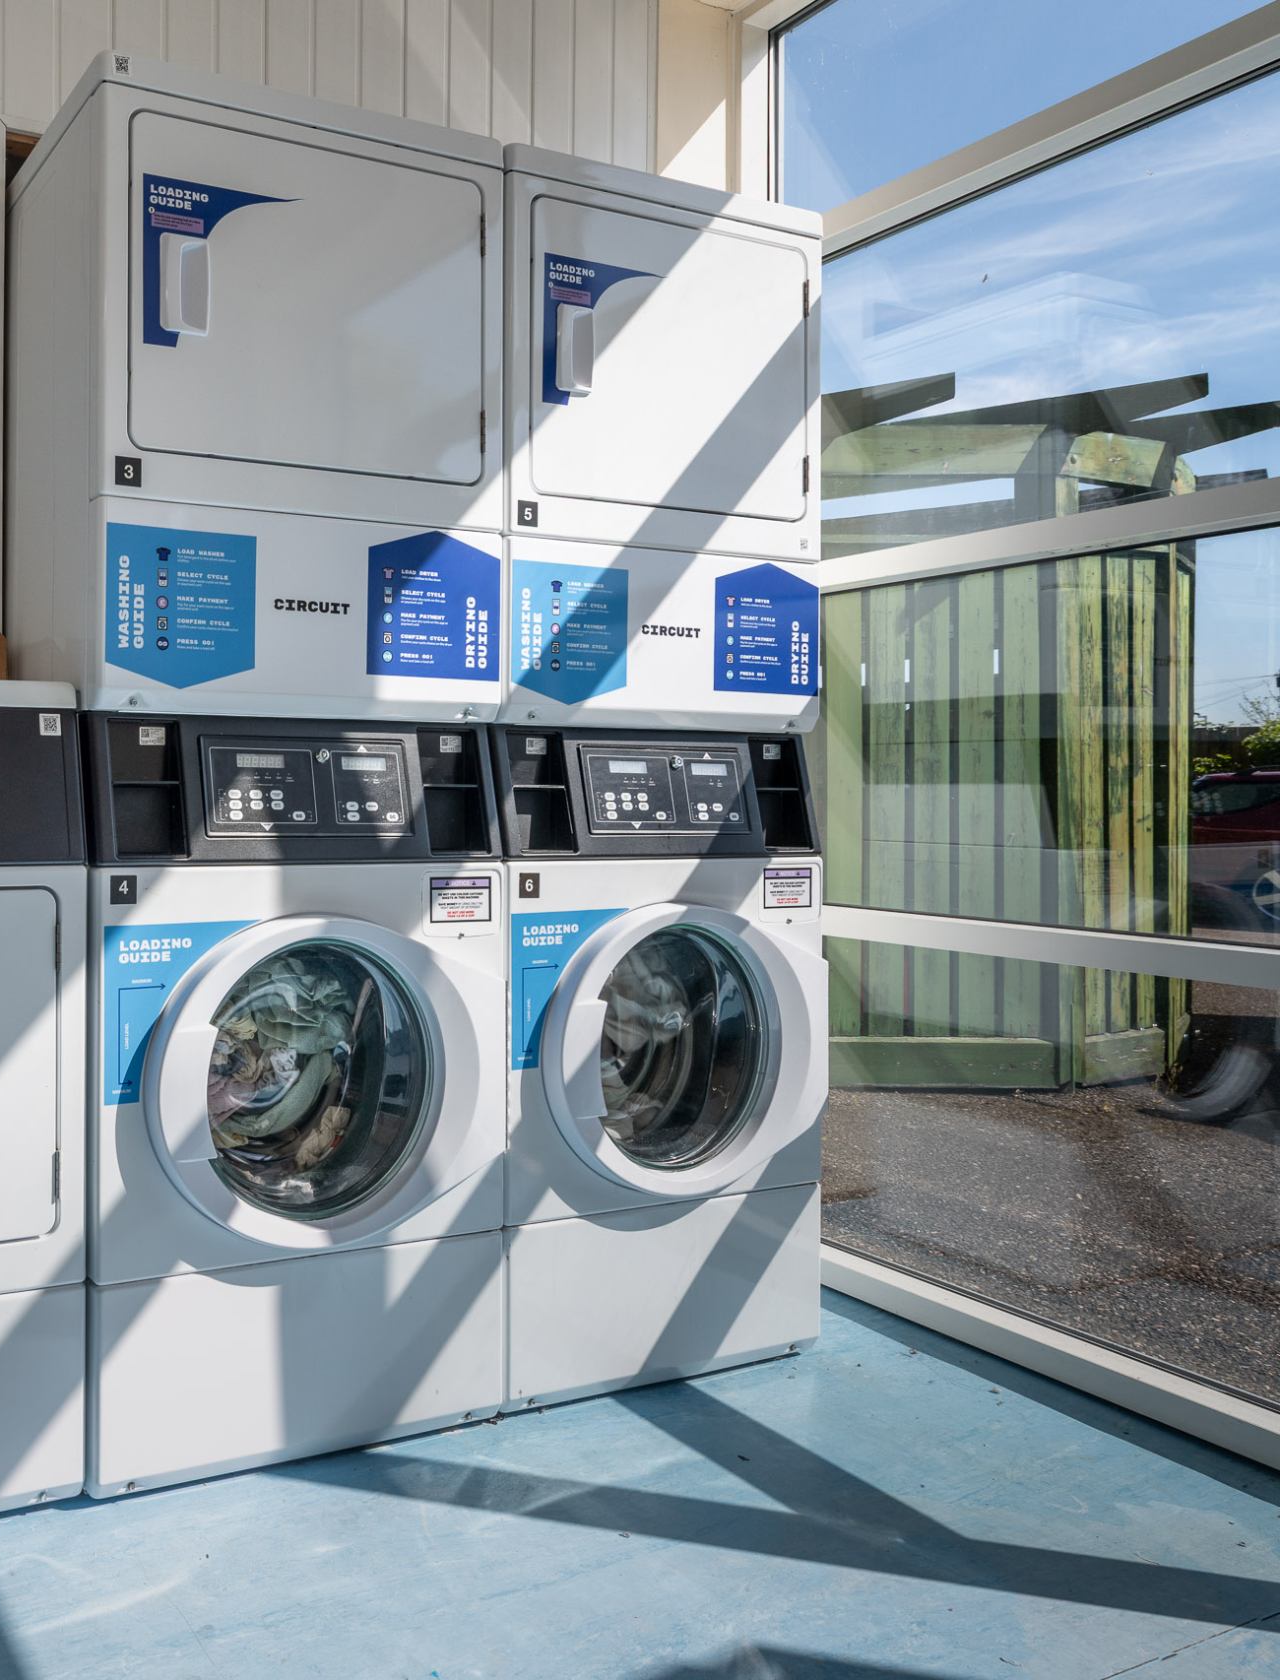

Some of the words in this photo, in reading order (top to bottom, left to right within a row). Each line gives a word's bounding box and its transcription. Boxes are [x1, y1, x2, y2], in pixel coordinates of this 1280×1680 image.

[150, 183, 209, 203] LOADING
[149, 195, 192, 211] GUIDE
[549, 261, 596, 278] LOADING
[549, 271, 582, 285] GUIDE
[124, 465, 133, 479] 3
[524, 508, 532, 521] 5
[118, 555, 130, 648] WASHING
[274, 598, 350, 615] CIRCUIT
[133, 583, 145, 649] GUIDE
[465, 596, 476, 668] DRYING
[521, 587, 530, 670] WASHING
[641, 624, 701, 639] CIRCUIT
[478, 610, 488, 669] GUIDE
[532, 612, 542, 670] GUIDE
[791, 621, 799, 684] DRYING
[801, 632, 809, 685] GUIDE
[119, 880, 129, 894] 4
[525, 879, 533, 891] 6
[523, 924, 579, 936] LOADING
[119, 937, 192, 952] LOADING
[522, 935, 563, 947] GUIDE
[118, 951, 171, 964] GUIDE
